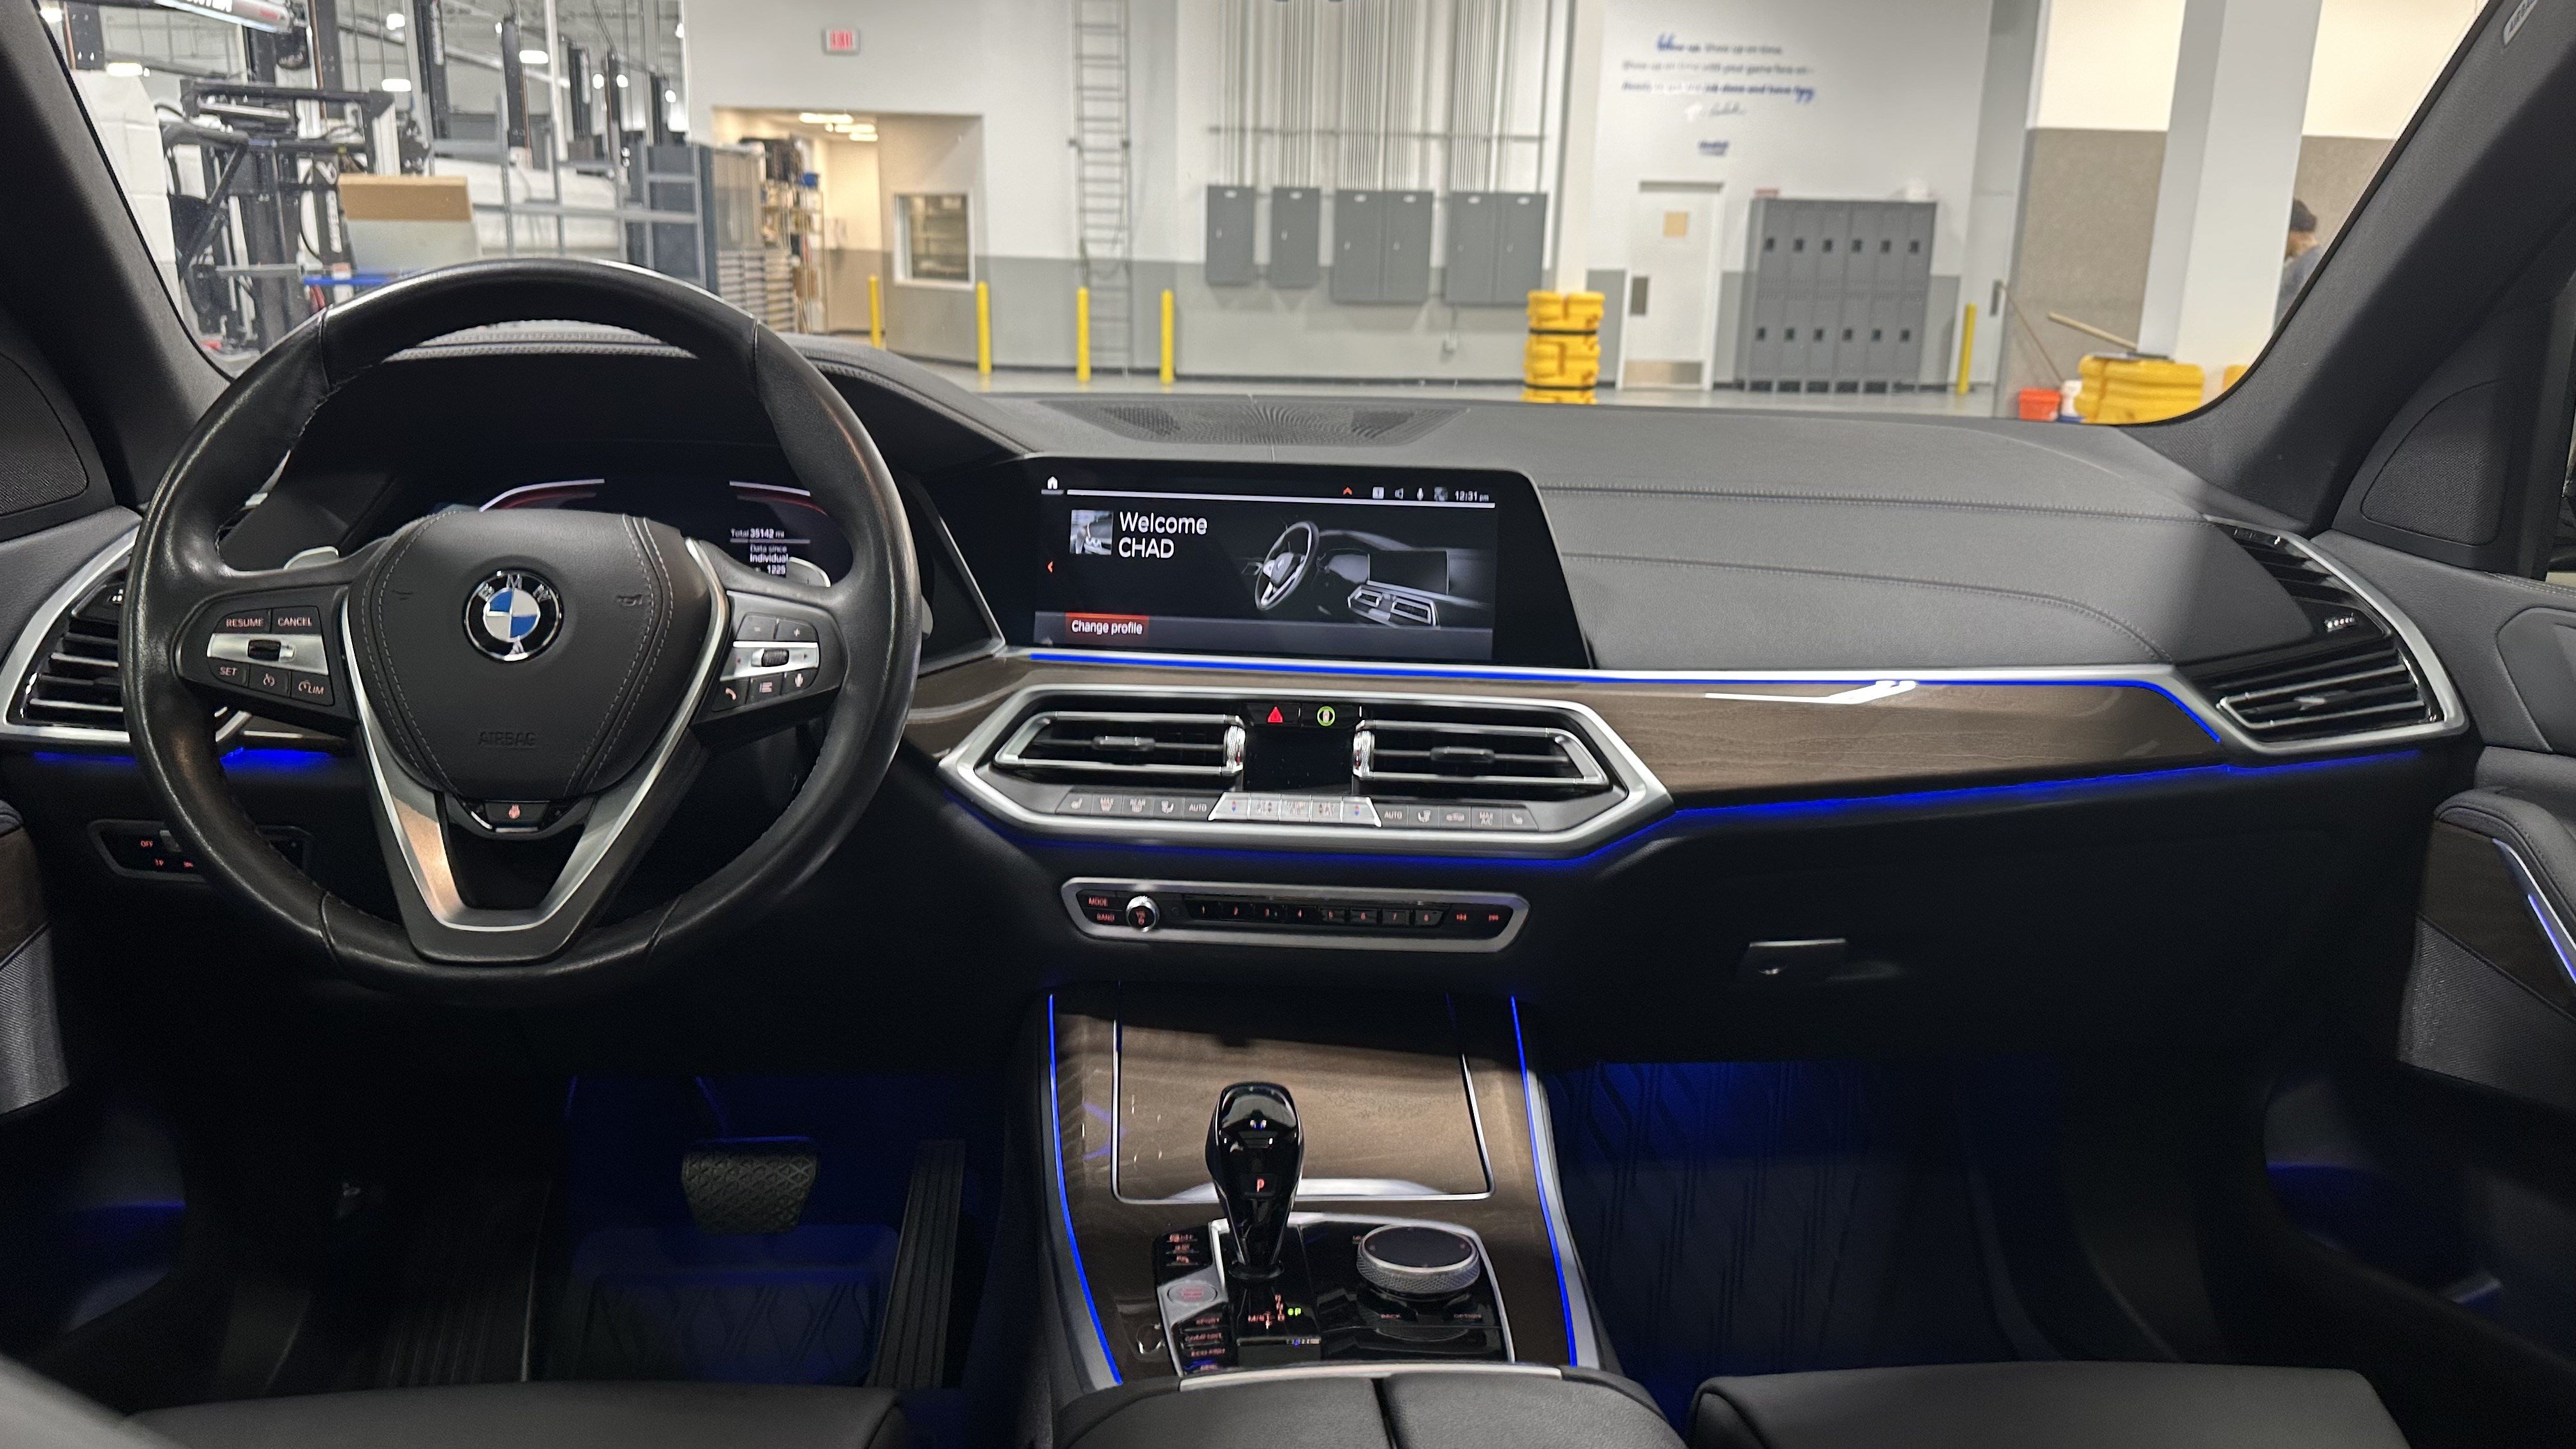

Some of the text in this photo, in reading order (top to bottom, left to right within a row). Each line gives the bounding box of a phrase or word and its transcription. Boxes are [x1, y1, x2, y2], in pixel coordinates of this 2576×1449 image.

[1119, 510, 1208, 535] Welcome
[730, 528, 749, 538] Total
[1118, 537, 1175, 559] CHAD
[749, 553, 788, 563] Individual
[226, 617, 264, 629] RESUME
[277, 617, 312, 627] CANCEL
[1071, 619, 1144, 637] Change profile
[219, 666, 237, 677] SET
[307, 685, 324, 695] LIM
[478, 731, 538, 746] AIRBAG
[1189, 803, 1207, 811] AUTO
[1384, 810, 1403, 820] AUTO
[1088, 896, 1108, 907] MODE
[1257, 1178, 1265, 1192] P
